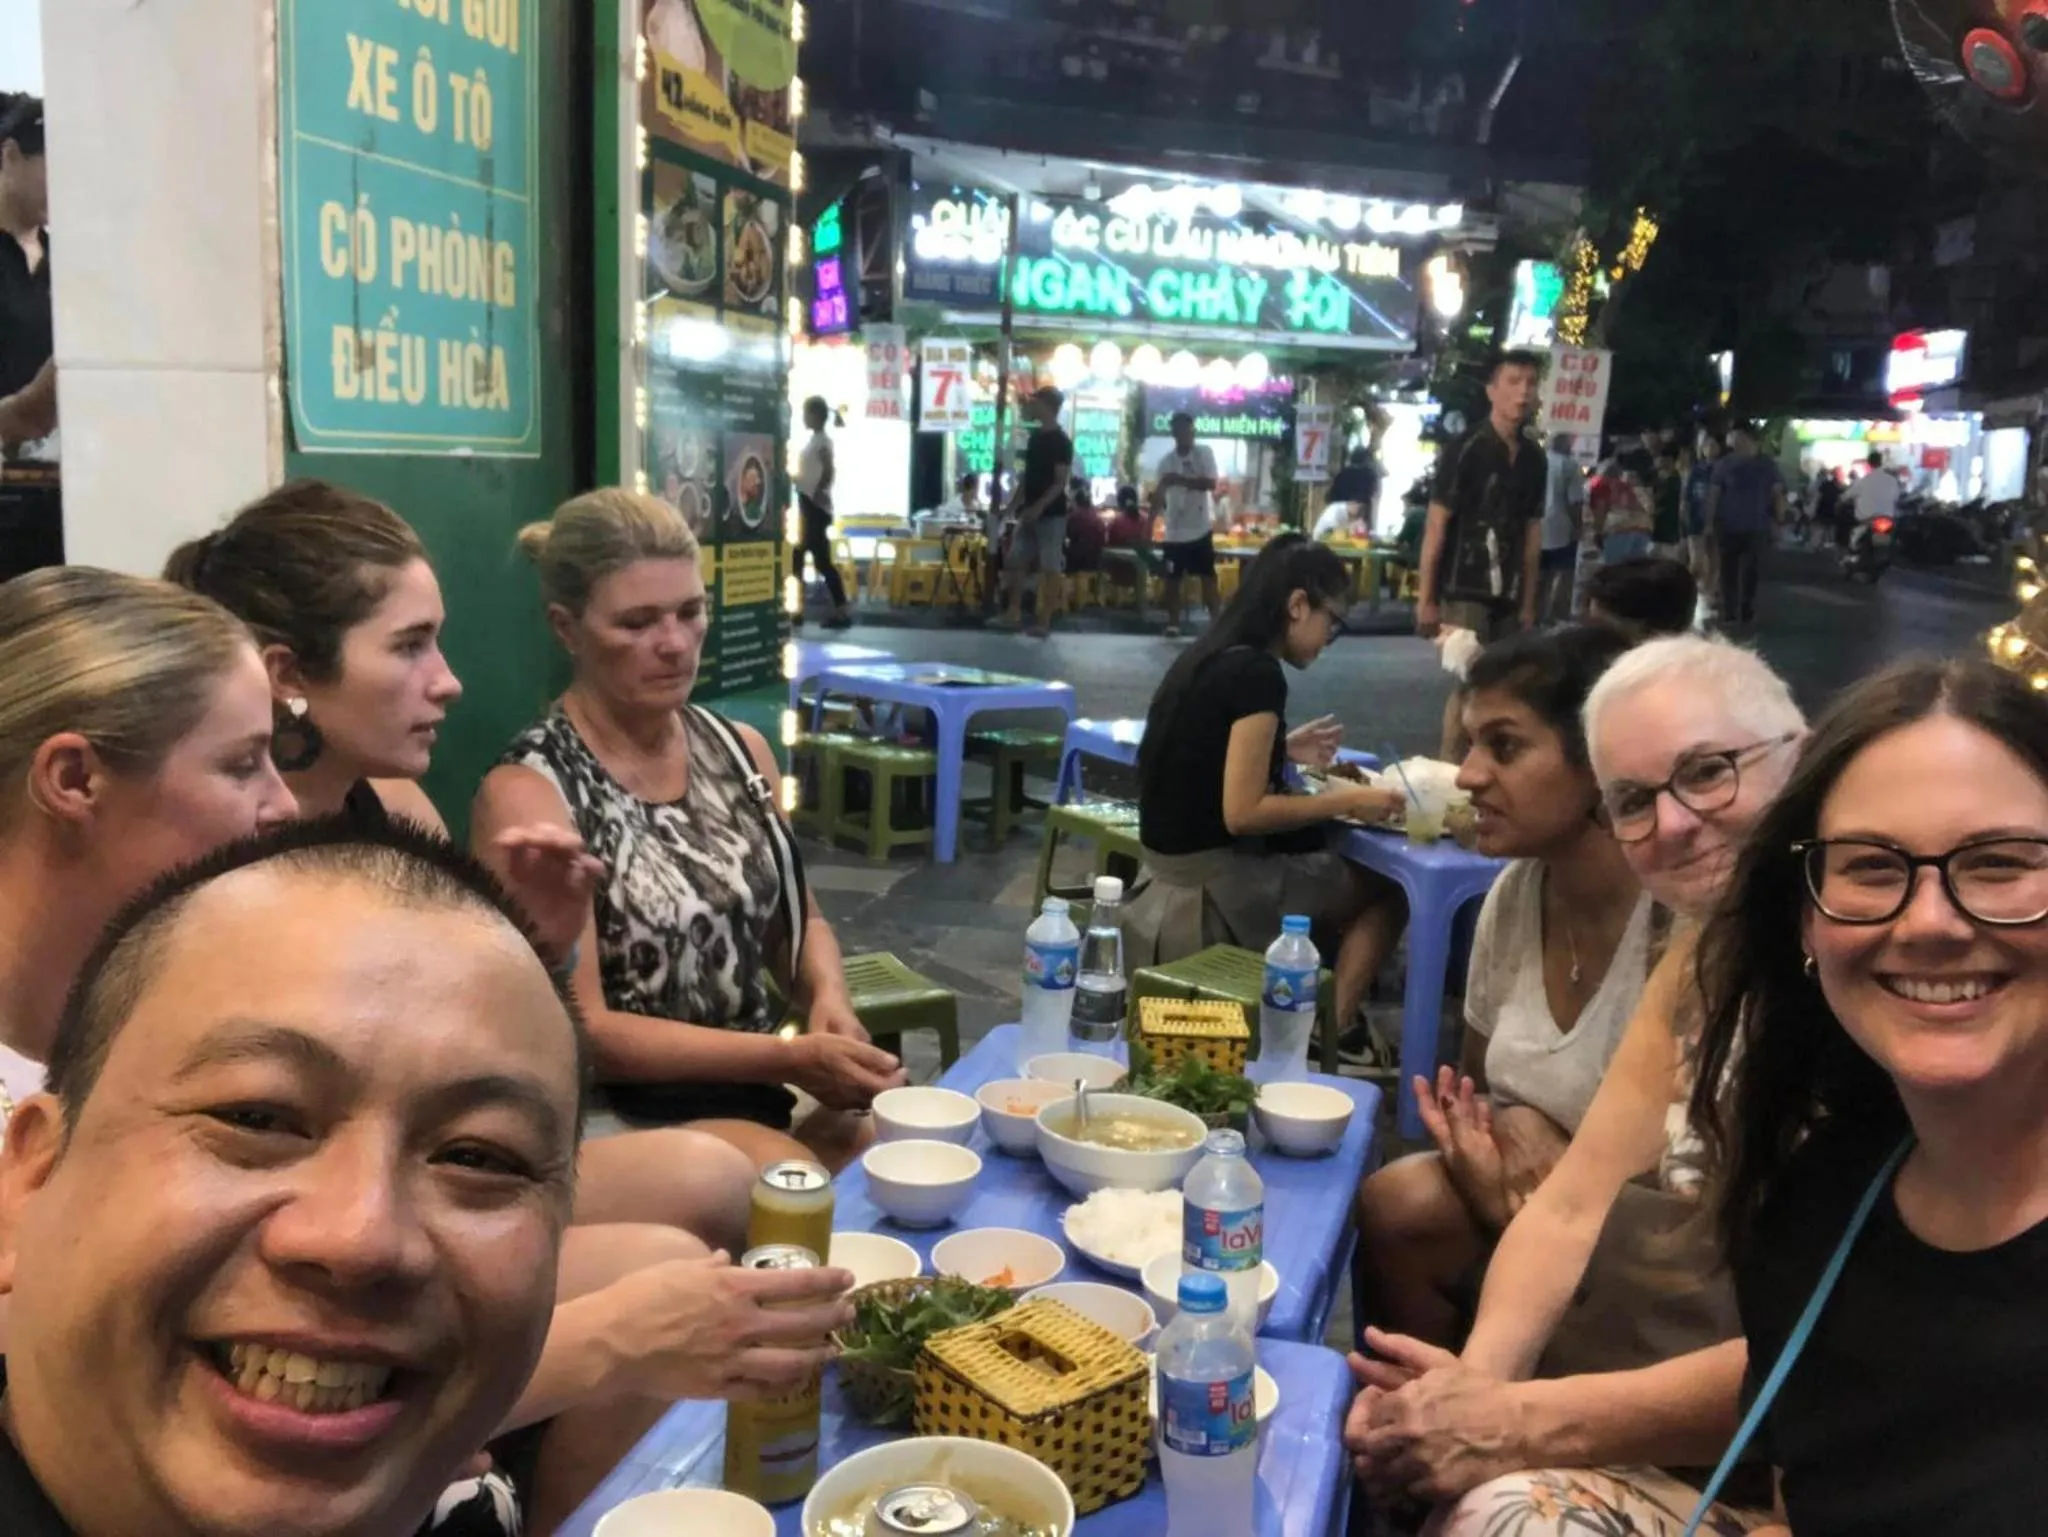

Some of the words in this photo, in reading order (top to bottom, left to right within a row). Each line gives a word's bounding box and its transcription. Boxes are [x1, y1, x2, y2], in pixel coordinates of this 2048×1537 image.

[347, 33, 399, 122] XE
[413, 45, 437, 132] Ô
[449, 67, 493, 150] TÔ
[320, 192, 376, 283] CÓ
[390, 211, 515, 306] PHÒNG
[438, 326, 509, 411] HÒA
